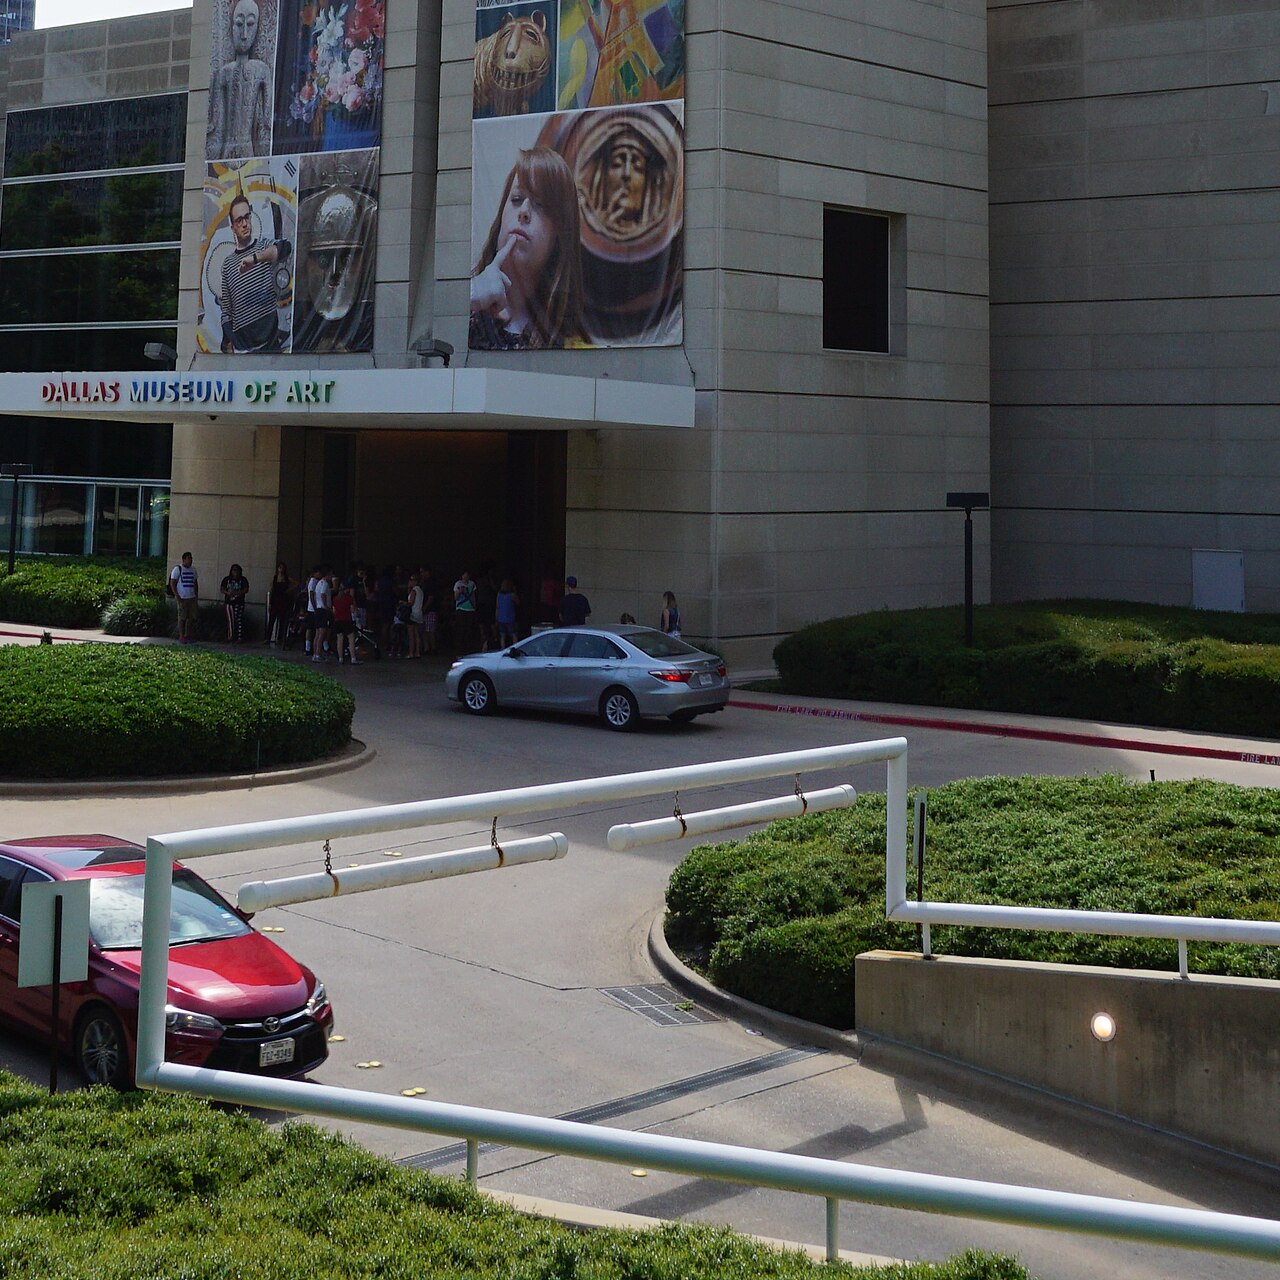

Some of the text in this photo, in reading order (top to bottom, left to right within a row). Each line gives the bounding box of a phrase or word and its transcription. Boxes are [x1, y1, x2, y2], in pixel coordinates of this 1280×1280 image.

[41, 380, 337, 403] DALLAS MUSEUM OF ART
[1240, 751, 1261, 764] FIRE
